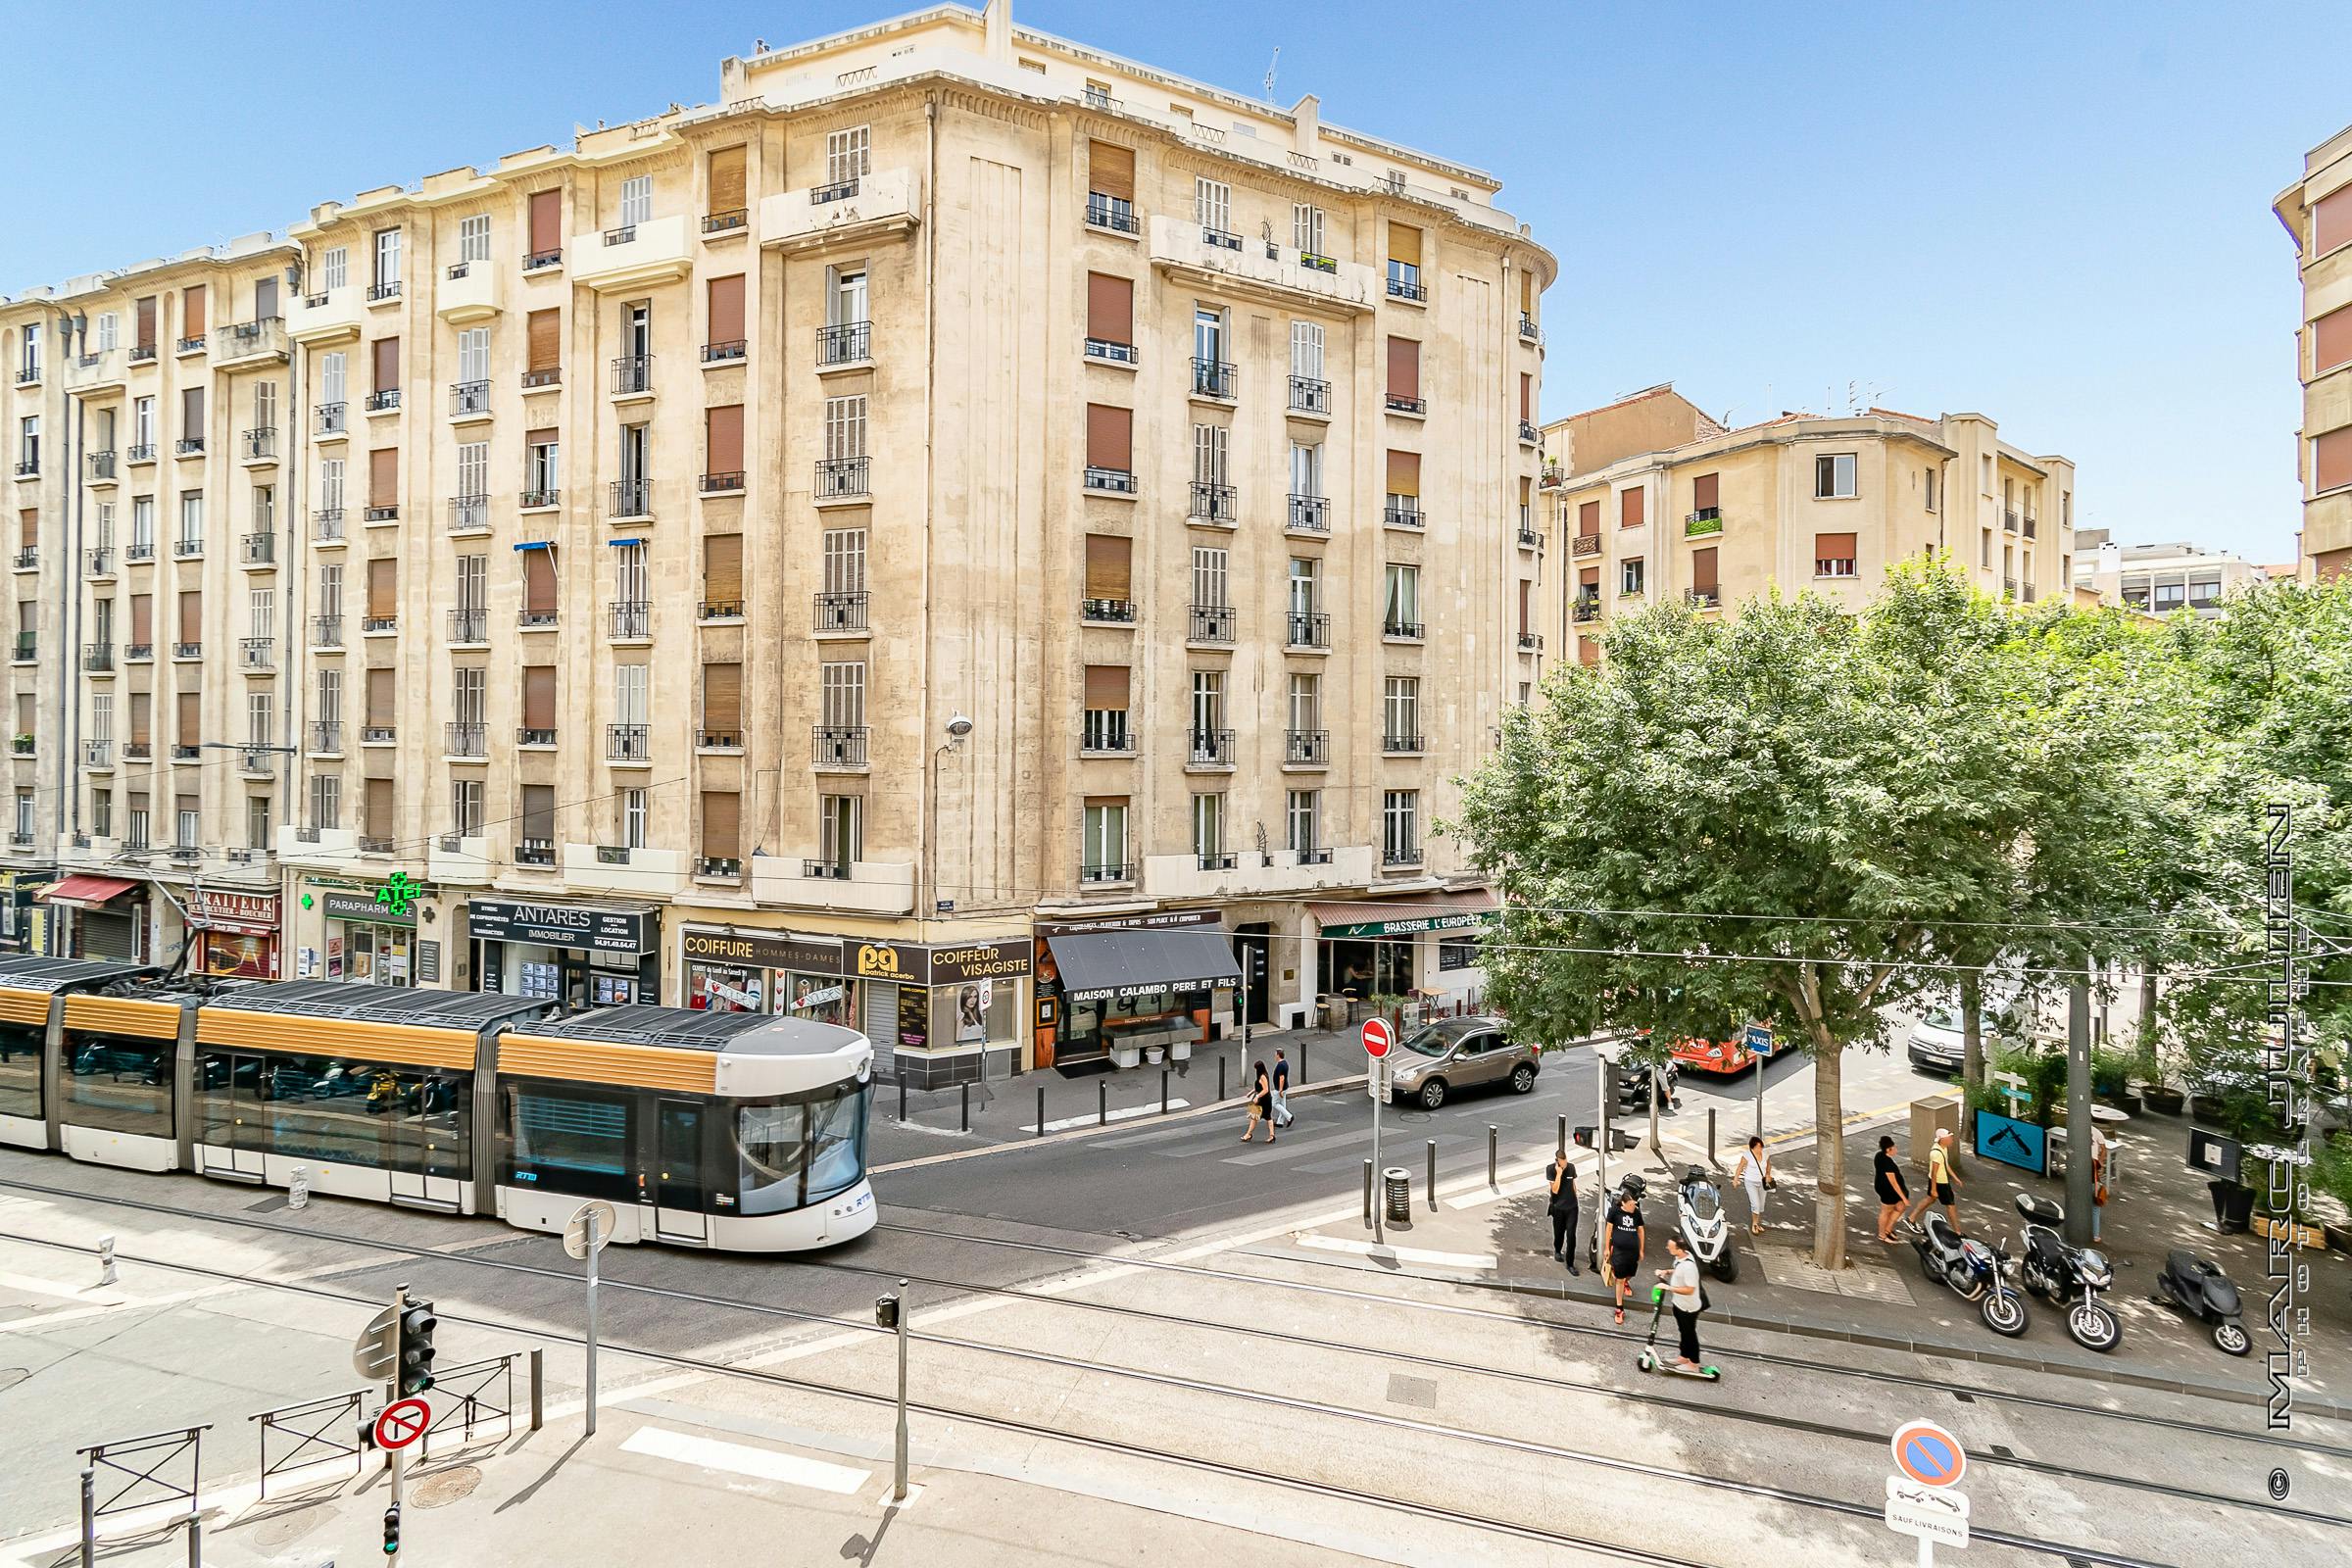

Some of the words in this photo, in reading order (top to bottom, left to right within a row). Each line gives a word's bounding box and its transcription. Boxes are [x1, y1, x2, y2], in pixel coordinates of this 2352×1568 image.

[194, 892, 271, 911] TRAITEUR
[329, 899, 413, 917] PARAPHARME
[193, 905, 234, 915] CHRCUTIER
[239, 909, 272, 919] BOUCHER
[514, 906, 591, 927] ANTARES
[600, 926, 629, 935] LOCATION
[1383, 919, 1430, 934] BRASSERIE
[528, 929, 575, 942] IMMOBILIER
[685, 936, 754, 958] COIFFURE
[756, 948, 841, 964] HOMMES-DAMES
[933, 948, 999, 965] COIFFEUR
[865, 968, 889, 977] patrick
[890, 971, 914, 980] acerbo
[960, 958, 1028, 977] VISAGISTE
[1073, 989, 1114, 1002] MAISON
[1119, 984, 1167, 998] CALAMBO
[1172, 981, 1197, 993] PERE
[1200, 979, 1213, 989] ET
[1217, 978, 1237, 988] FILS
[1747, 1034, 1769, 1047] TAXIS
[1892, 1514, 1913, 1524] SAUF
[1914, 1520, 1963, 1538] LIVRAISONS
